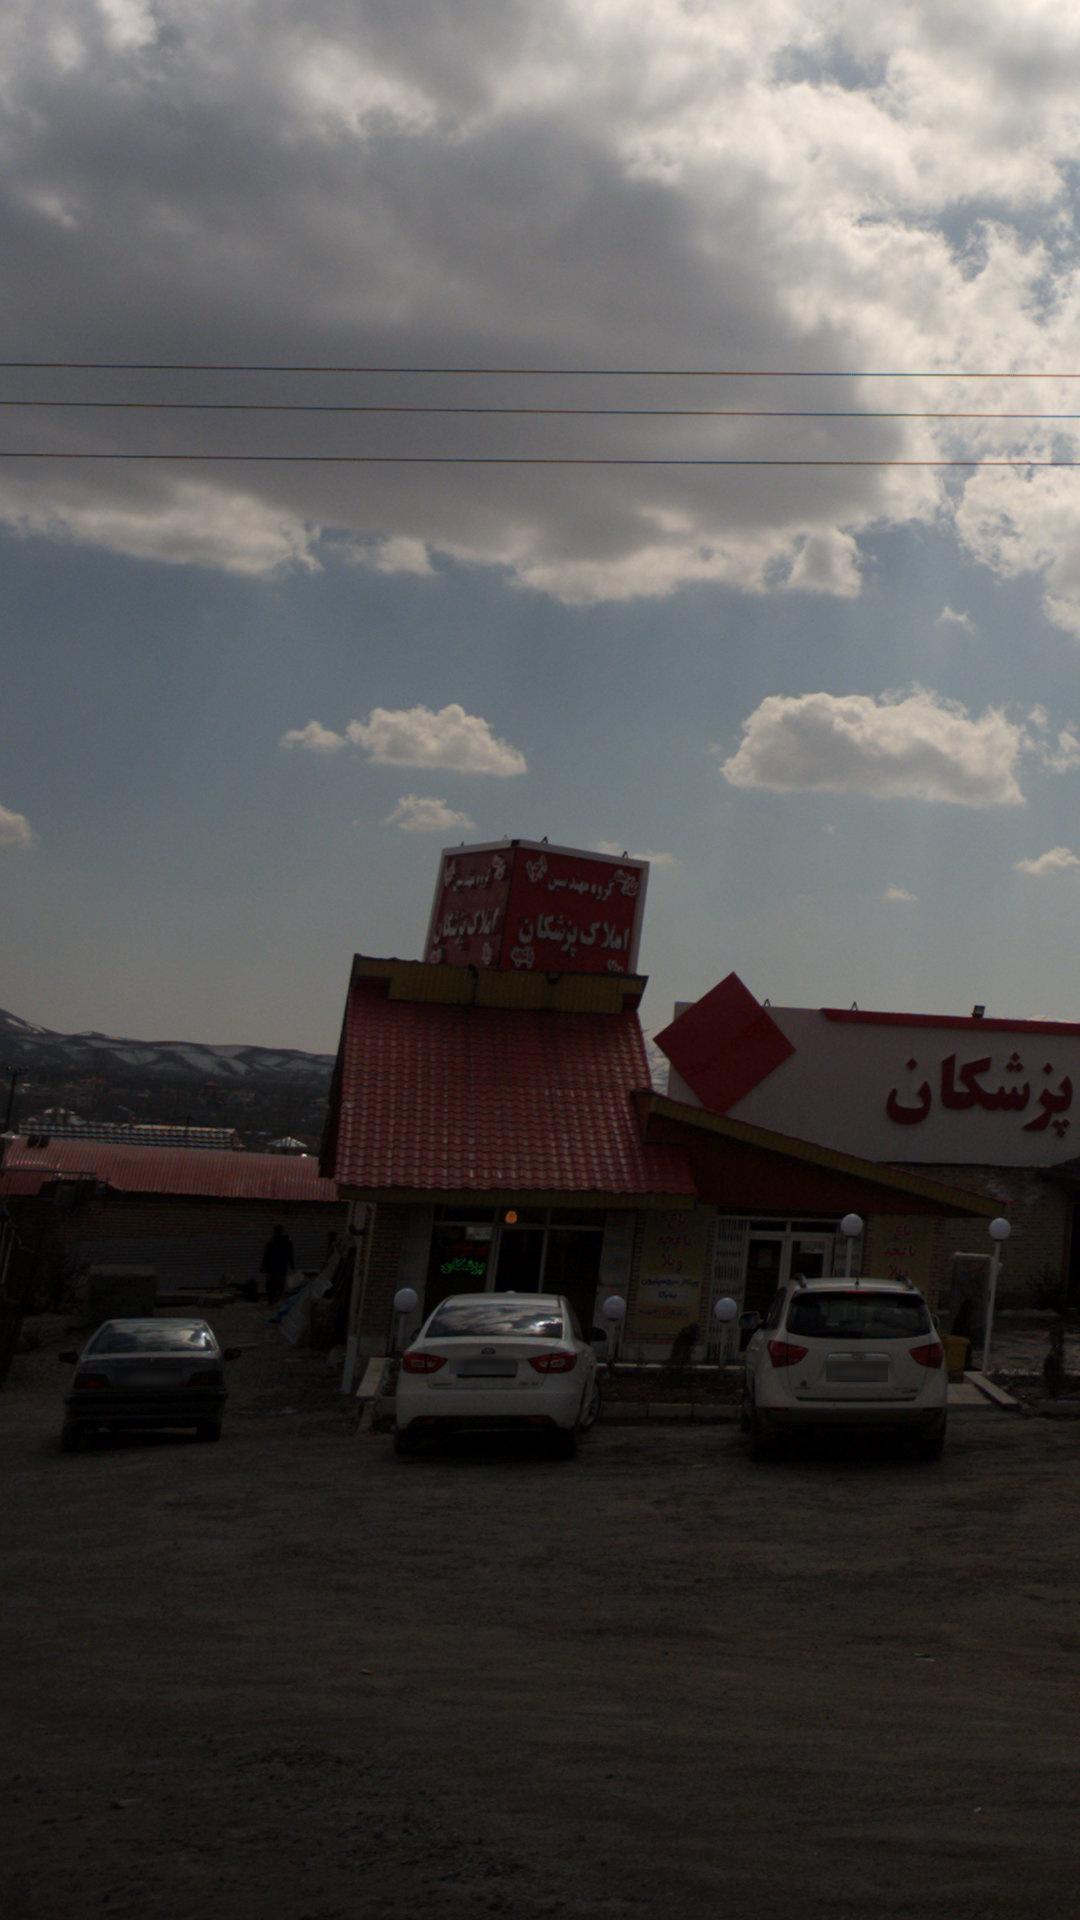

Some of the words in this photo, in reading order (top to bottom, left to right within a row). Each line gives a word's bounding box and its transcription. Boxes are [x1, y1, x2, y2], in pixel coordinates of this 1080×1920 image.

[517, 911, 578, 957] پزشکان
[578, 919, 631, 951] املاک
[886, 1052, 1074, 1138] پزشکان
